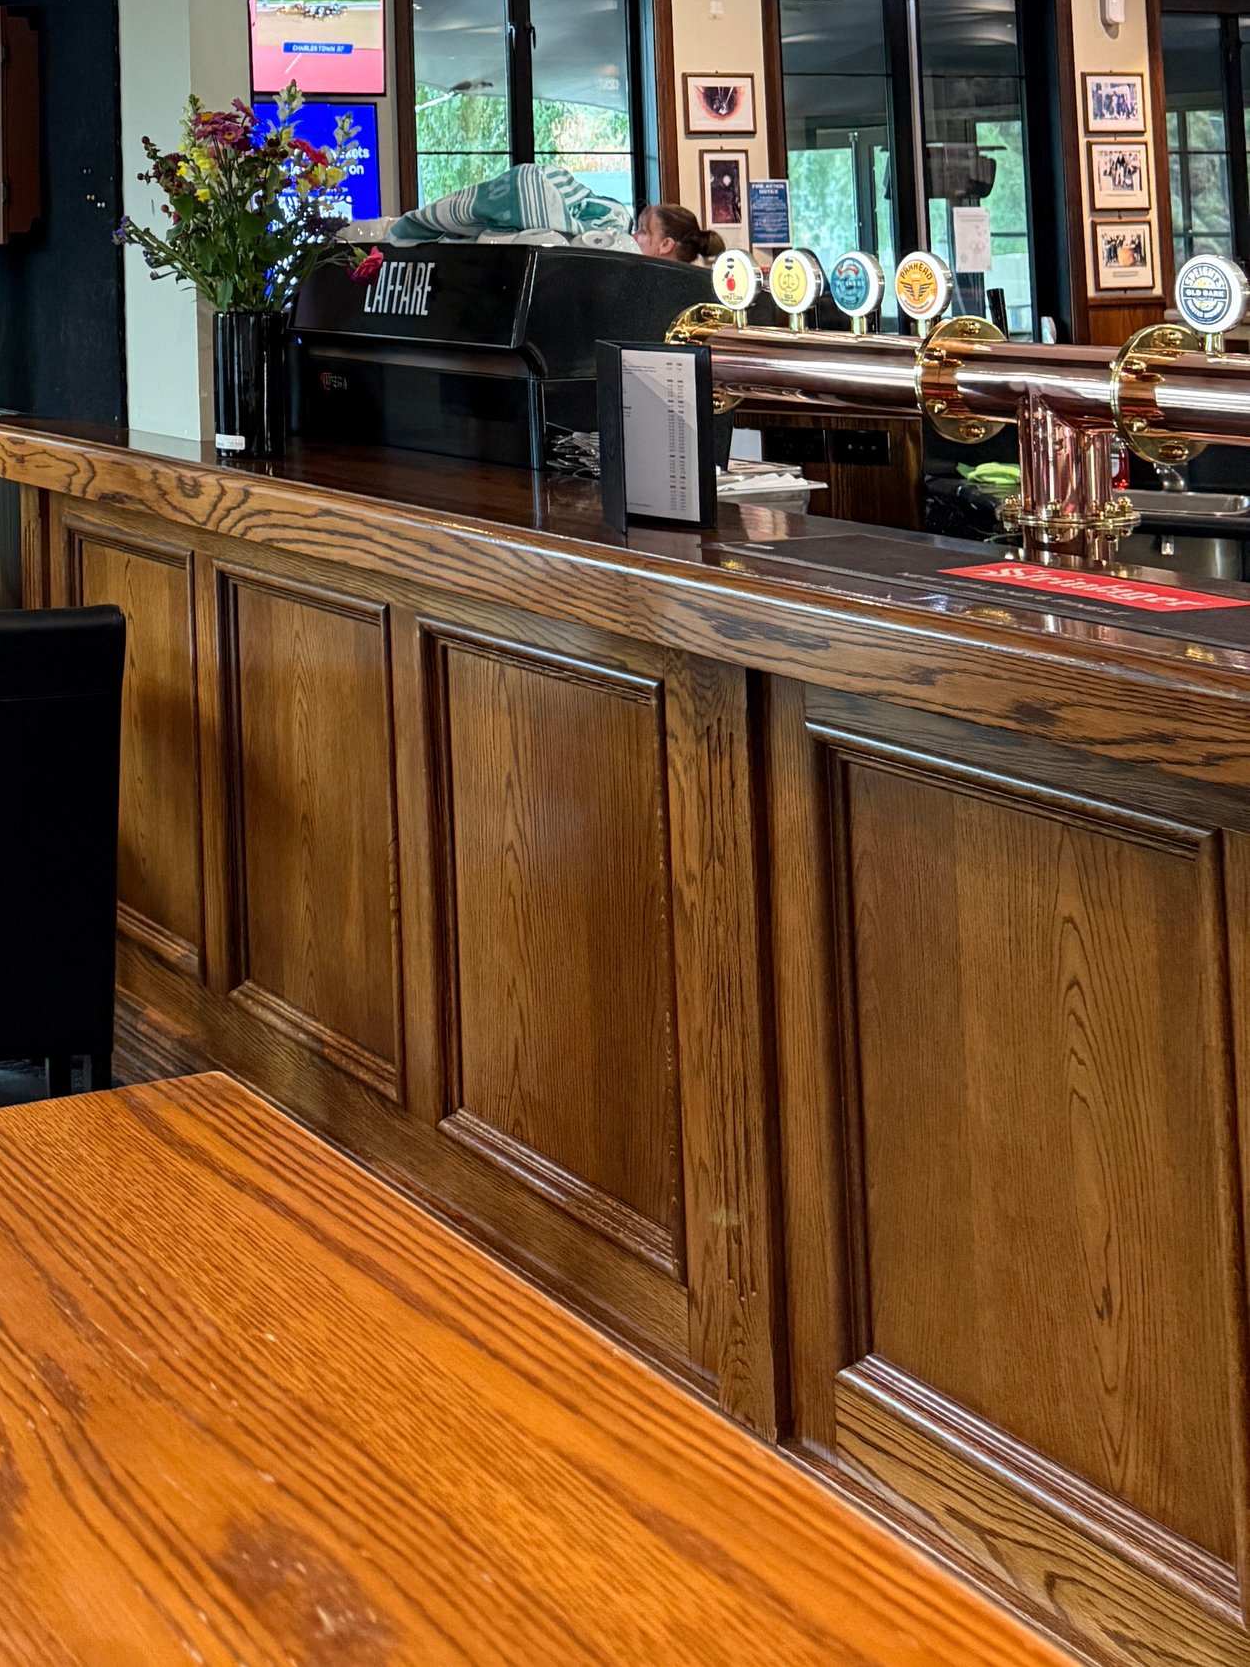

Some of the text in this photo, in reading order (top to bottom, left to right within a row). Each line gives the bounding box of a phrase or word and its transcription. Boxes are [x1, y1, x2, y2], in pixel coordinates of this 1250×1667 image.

[900, 262, 933, 281] PANHEAD
[1185, 289, 1225, 298] OLD DARK
[976, 565, 1206, 607] Steinlager
